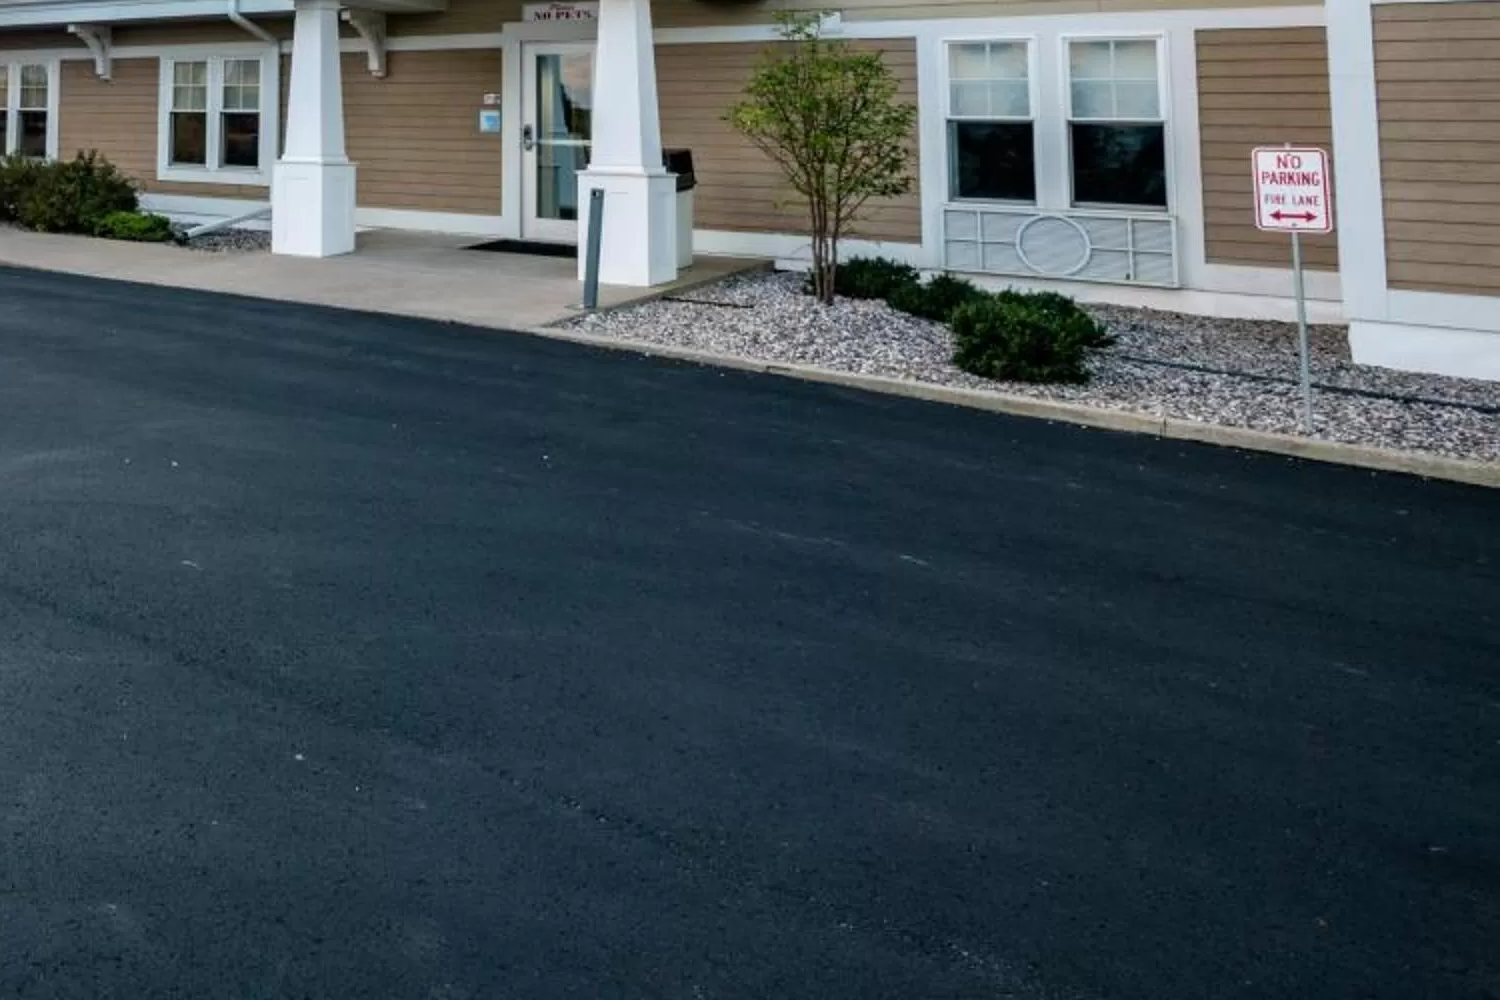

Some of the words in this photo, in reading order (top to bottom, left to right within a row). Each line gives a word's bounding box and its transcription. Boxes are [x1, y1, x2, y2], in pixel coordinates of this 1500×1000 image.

[1277, 155, 1302, 169] NO
[1261, 171, 1320, 187] PARKING
[1292, 195, 1321, 207] LANE
